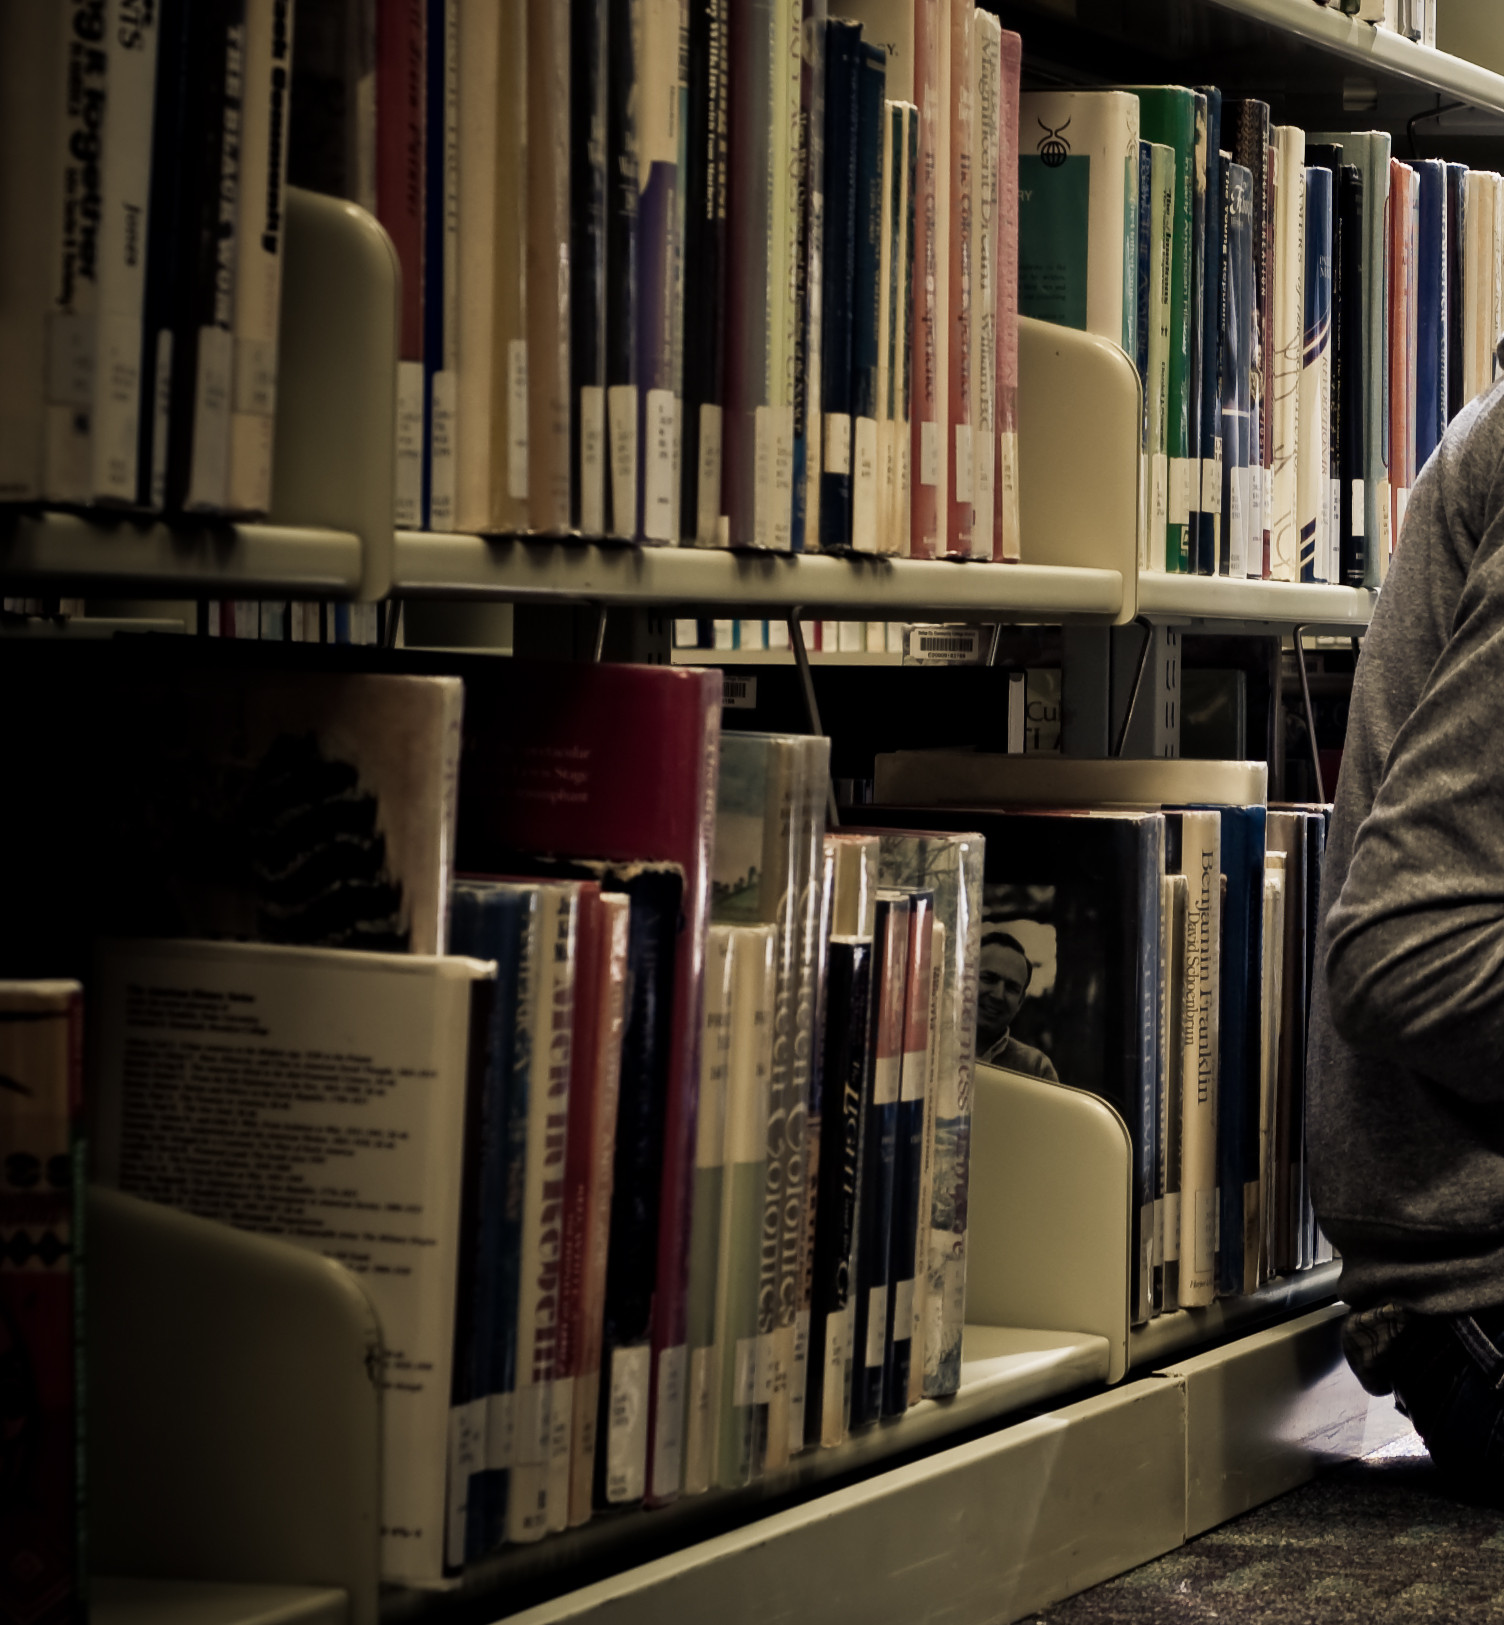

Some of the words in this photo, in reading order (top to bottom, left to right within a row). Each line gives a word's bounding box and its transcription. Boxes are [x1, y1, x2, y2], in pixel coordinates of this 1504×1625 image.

[224, 25, 244, 98] THE
[708, 22, 719, 99] Wilkins
[979, 34, 994, 191] Magnificent
[218, 105, 240, 225] BLACK
[960, 153, 971, 185] The
[1262, 131, 1270, 212] AMERICAN
[124, 203, 144, 268] Jones
[1222, 205, 1230, 255] Young
[980, 312, 990, 391] William
[1186, 910, 1201, 952] David
[1195, 848, 1214, 981] Benjamin
[1144, 970, 1153, 1075] LITTLE
[1185, 955, 1200, 1046] Schoenbrun
[1197, 989, 1213, 1106] Franklin
[843, 1081, 860, 1195] LIGHT
[758, 1108, 788, 1335] Colonies
[779, 1100, 808, 1328] Colonies
